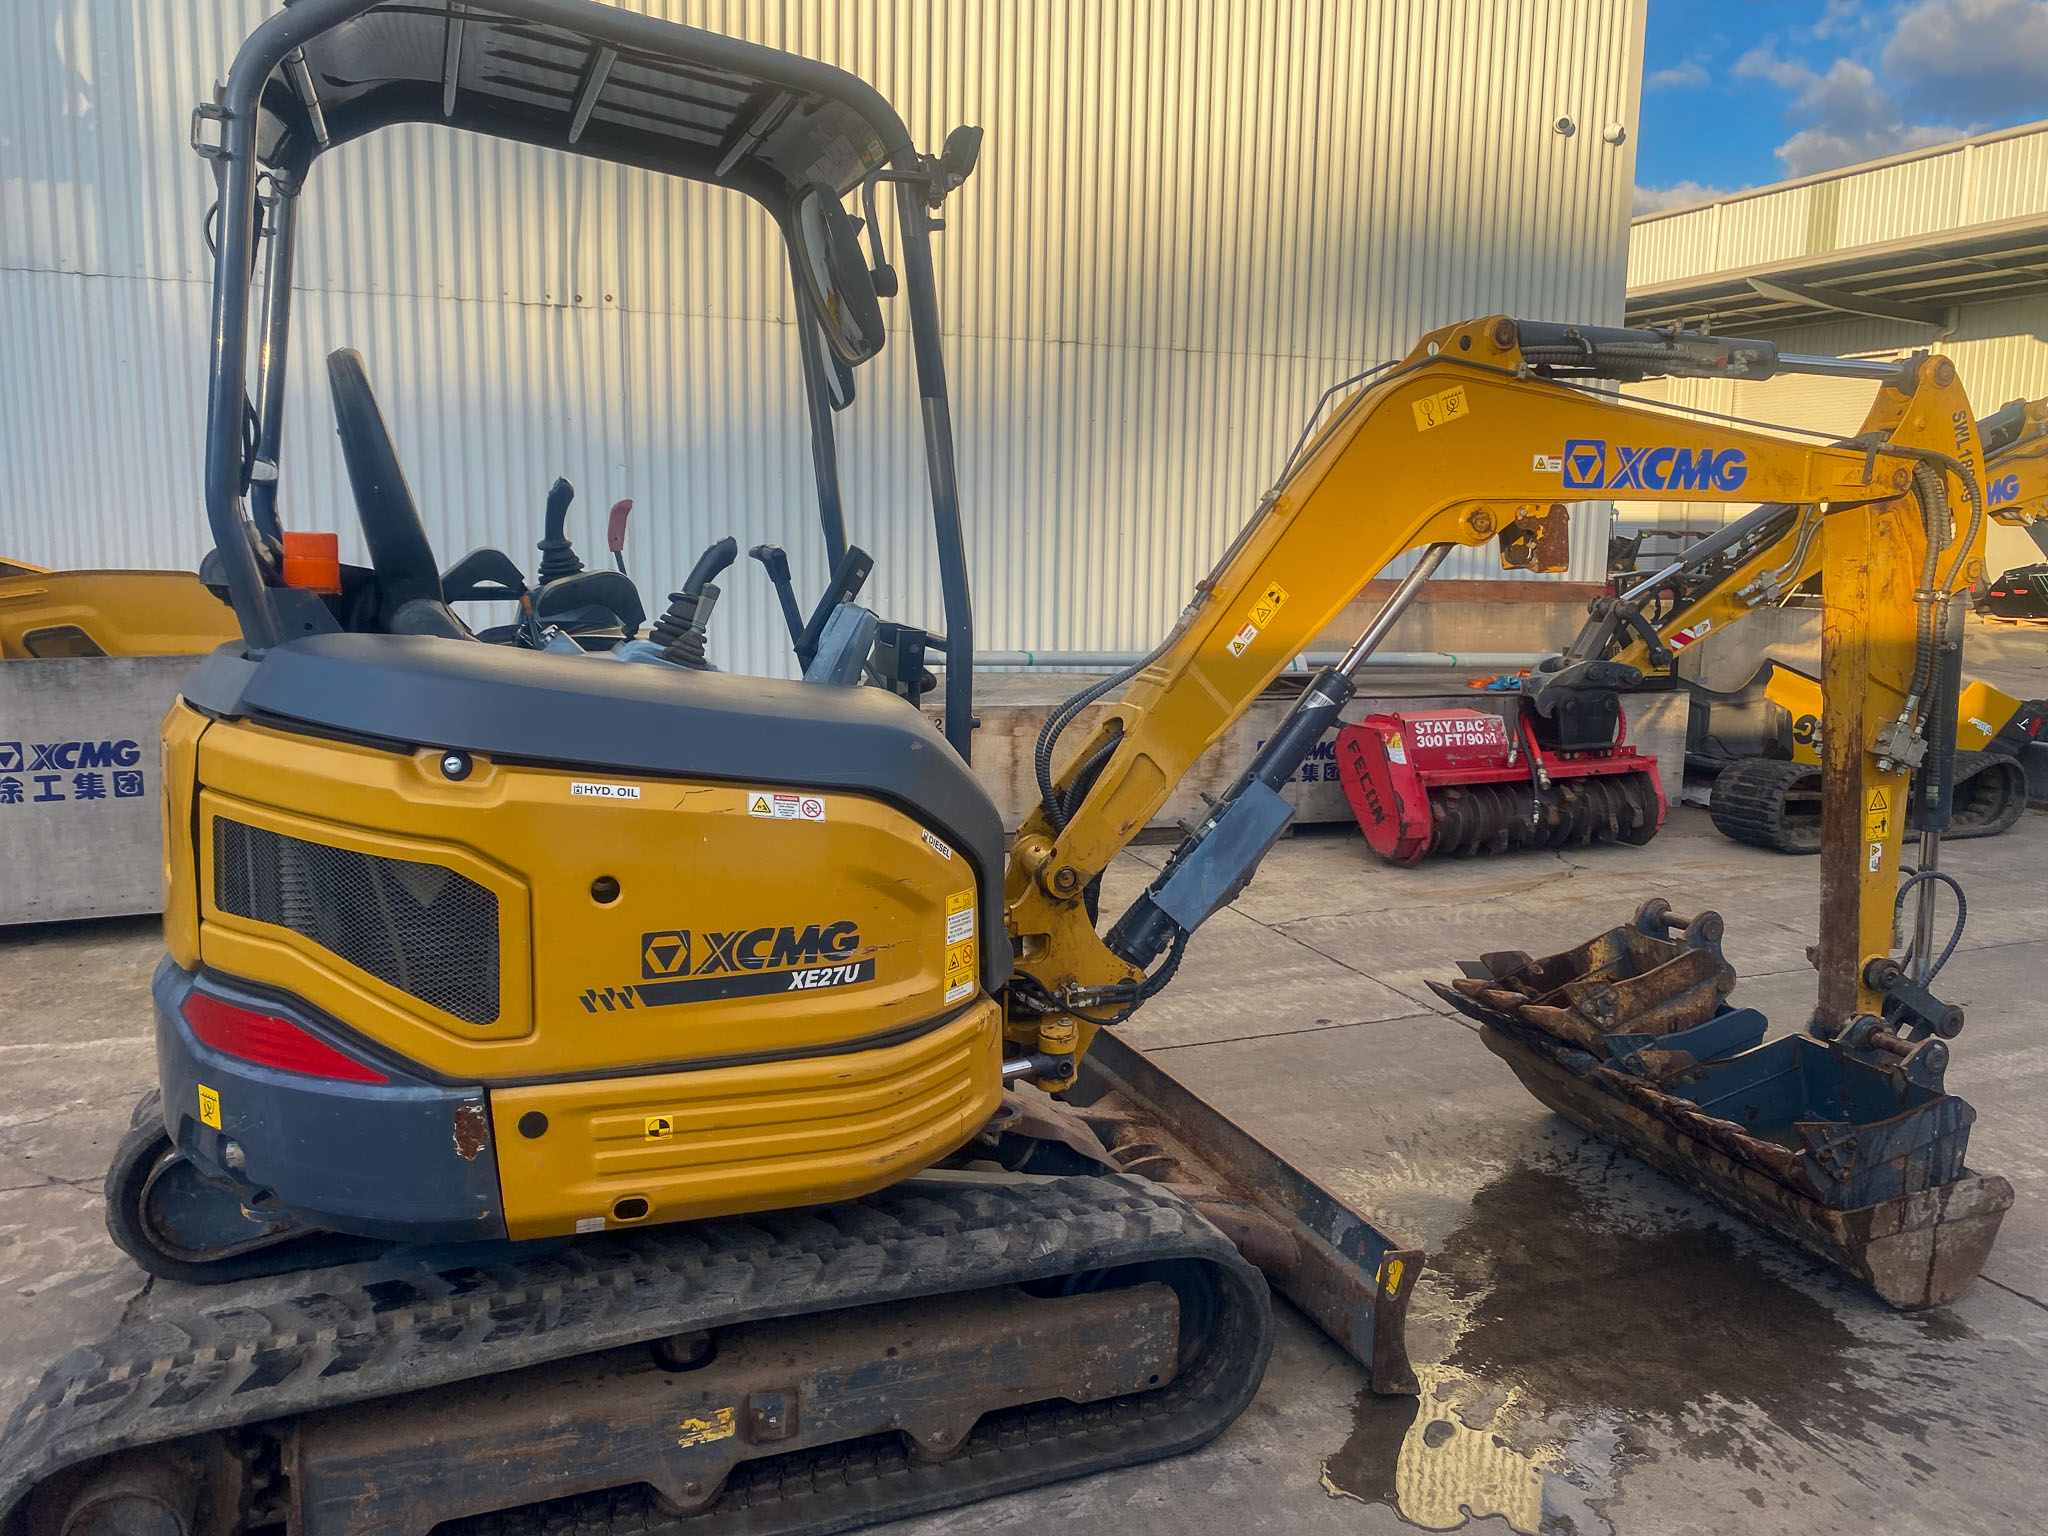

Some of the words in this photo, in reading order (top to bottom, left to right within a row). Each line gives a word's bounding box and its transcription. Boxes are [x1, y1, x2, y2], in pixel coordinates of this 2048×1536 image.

[1602, 446, 1748, 491] XCMG
[1415, 721, 1452, 734] STAY
[1456, 720, 1497, 733] BAC
[1416, 734, 1443, 748] 300
[26, 739, 141, 771] XCMG
[584, 785, 614, 796] HYD.
[617, 787, 638, 798] OIL
[1346, 739, 1386, 825] FECON
[928, 835, 950, 858] DIESEL
[691, 920, 860, 975] XCMG
[788, 963, 861, 990] XE27U
